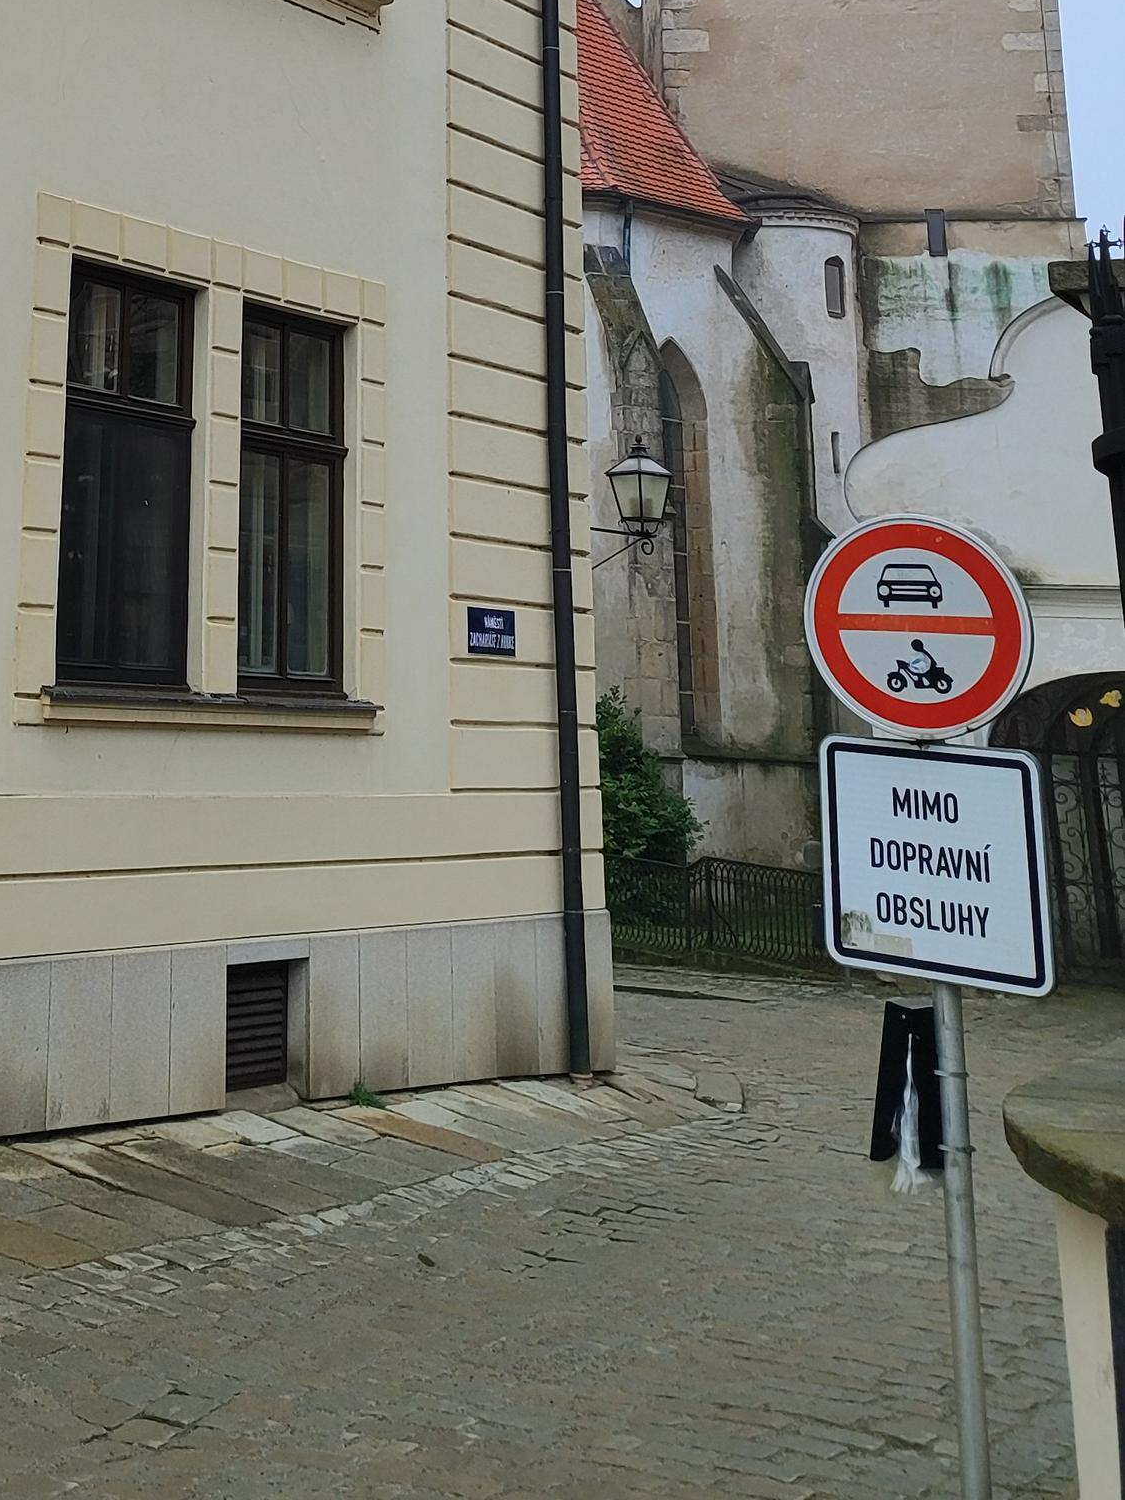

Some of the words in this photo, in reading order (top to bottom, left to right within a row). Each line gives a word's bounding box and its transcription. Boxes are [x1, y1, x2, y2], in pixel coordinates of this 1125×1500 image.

[892, 787, 959, 824] MIMO
[870, 837, 991, 883] DOPRAVNÍ
[876, 892, 989, 938] OBSLUHY
